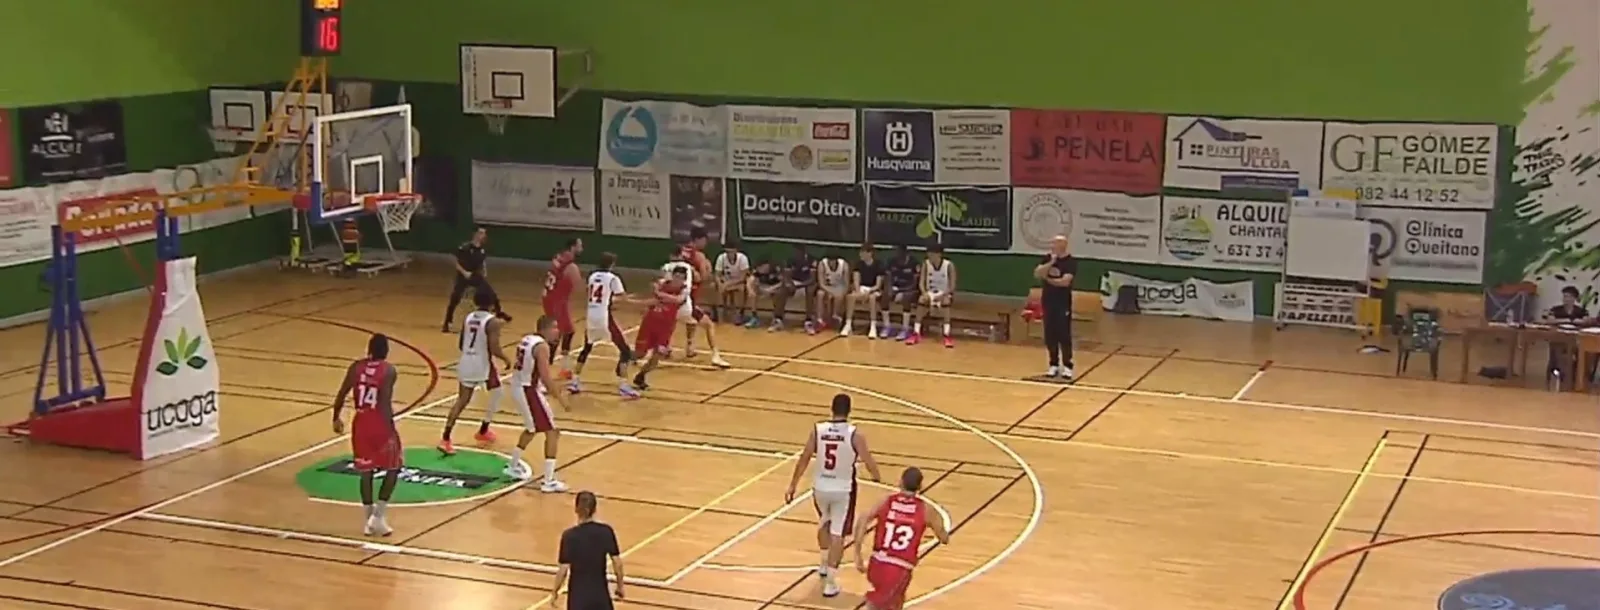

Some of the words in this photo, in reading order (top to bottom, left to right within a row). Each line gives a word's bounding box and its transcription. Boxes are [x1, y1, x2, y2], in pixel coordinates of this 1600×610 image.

[319, 17, 338, 50] 16
[1054, 136, 1157, 165] PENELA
[1206, 144, 1280, 160] PINTURAS
[1330, 134, 1398, 173] GF
[867, 156, 931, 172] Husqvarna
[1402, 156, 1488, 176] FAILDE
[744, 194, 806, 214] Doctor
[1390, 188, 1409, 200] 44
[1417, 189, 1433, 202] 12
[1440, 189, 1459, 203] 52
[1406, 219, 1464, 239] Clínica
[1228, 244, 1252, 257] 637
[1256, 246, 1272, 258] 37
[1405, 238, 1480, 256] Queitano
[588, 284, 604, 303] 14
[1137, 283, 1198, 304] ucoga
[469, 327, 478, 348] 7
[357, 385, 378, 409] 14
[147, 390, 218, 431] ucoga
[824, 443, 838, 470] 5
[883, 522, 914, 551] 13
